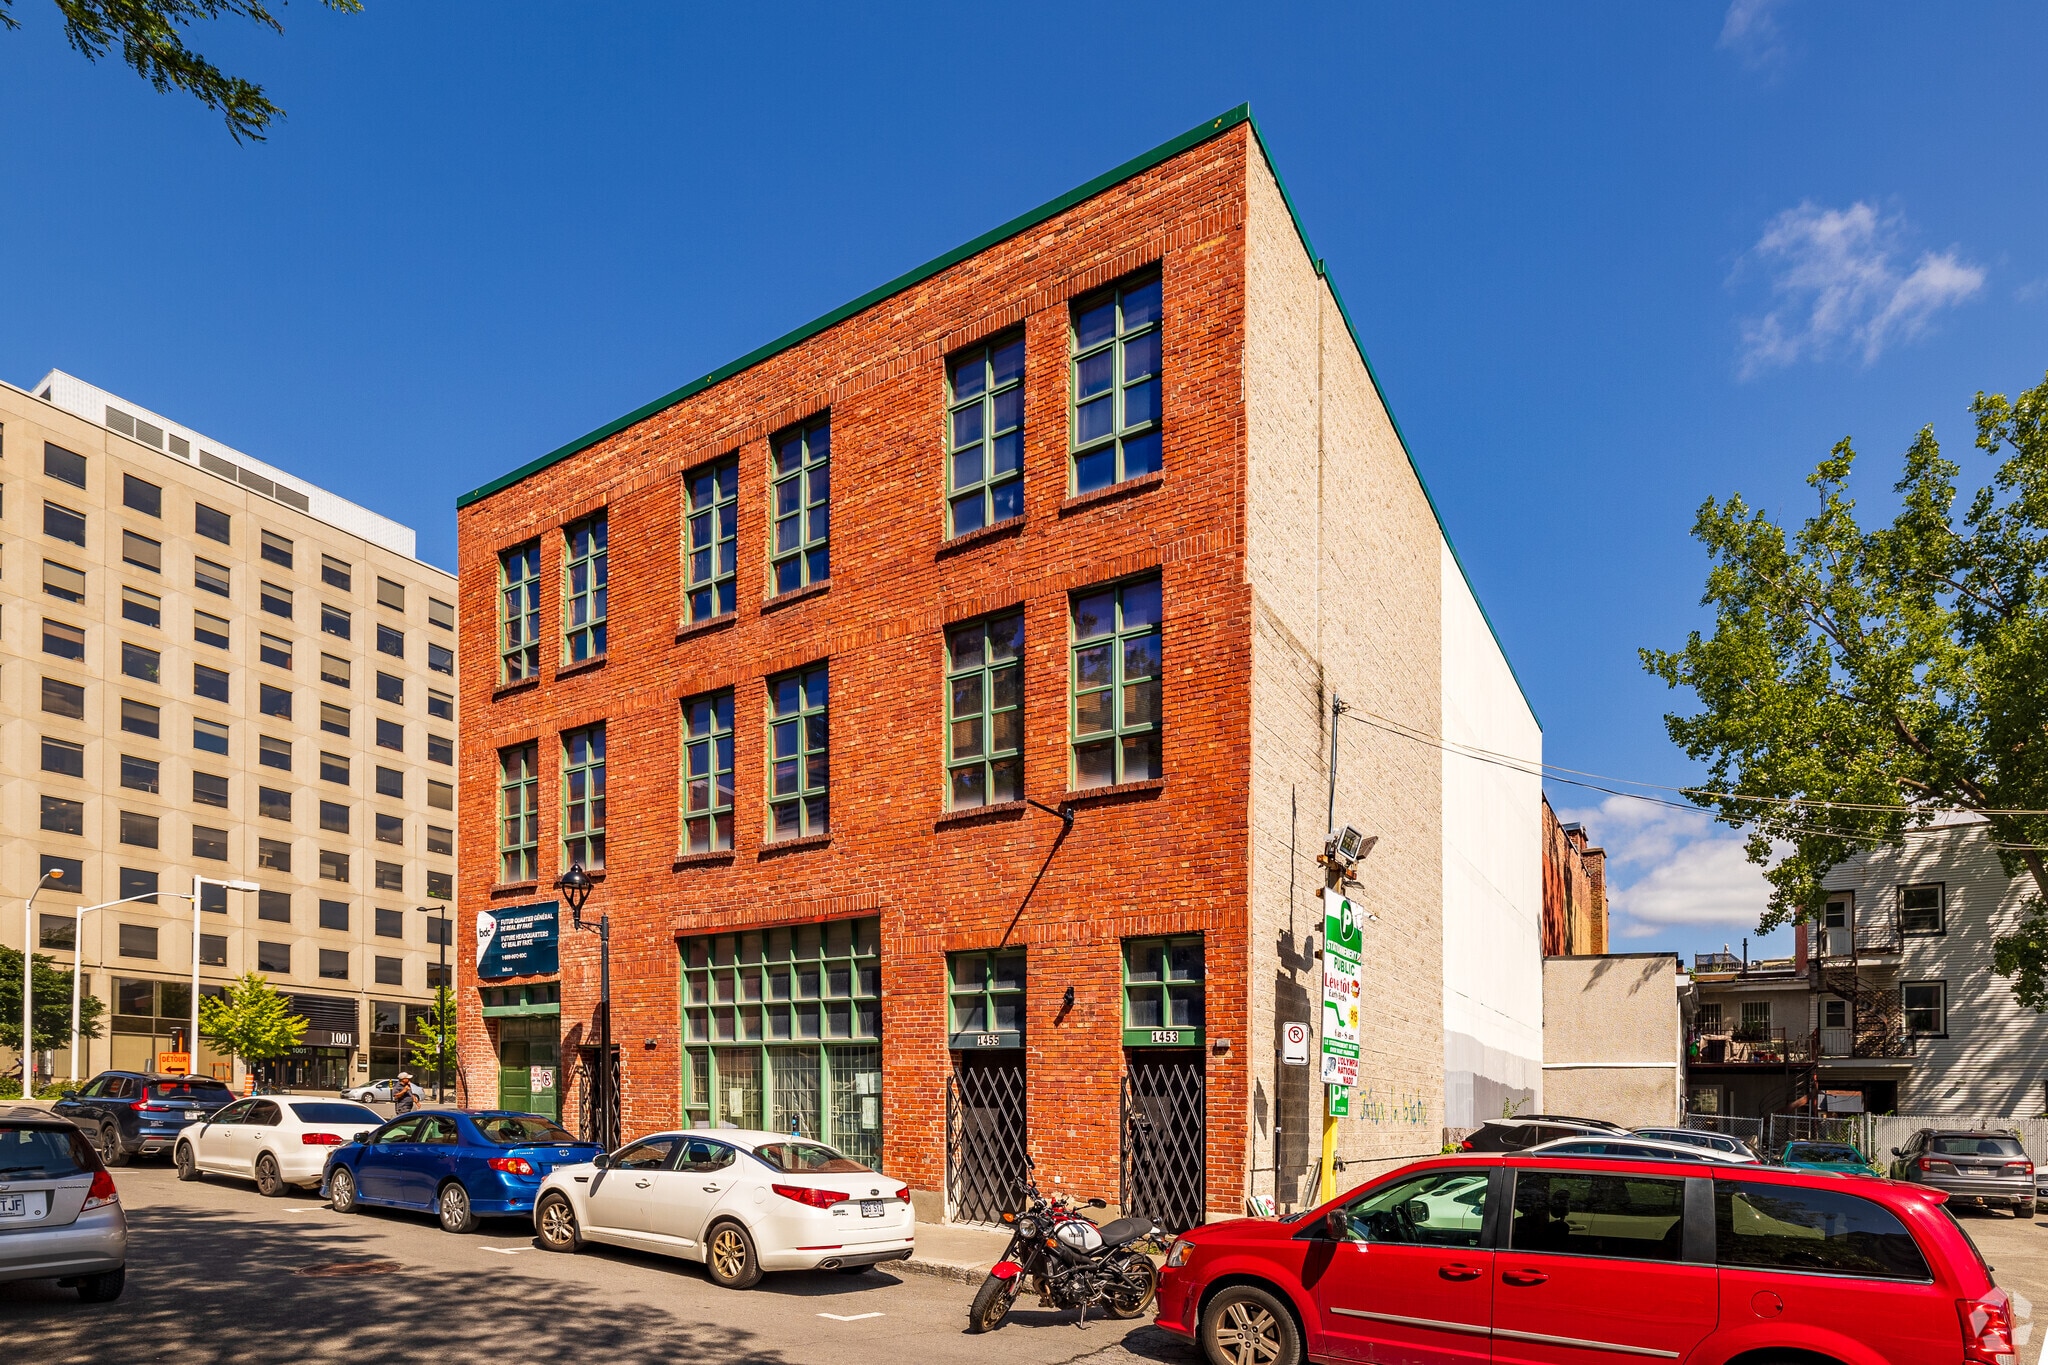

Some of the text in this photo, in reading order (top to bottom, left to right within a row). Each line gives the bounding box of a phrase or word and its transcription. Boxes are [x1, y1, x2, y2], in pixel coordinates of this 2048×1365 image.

[479, 928, 490, 937] bdc
[1334, 957, 1355, 976] PUBLIC
[331, 1032, 352, 1044] 1001
[978, 1035, 999, 1046] 1455
[1152, 1031, 1178, 1043] 1453
[1338, 1066, 1357, 1077] NATIONAL
